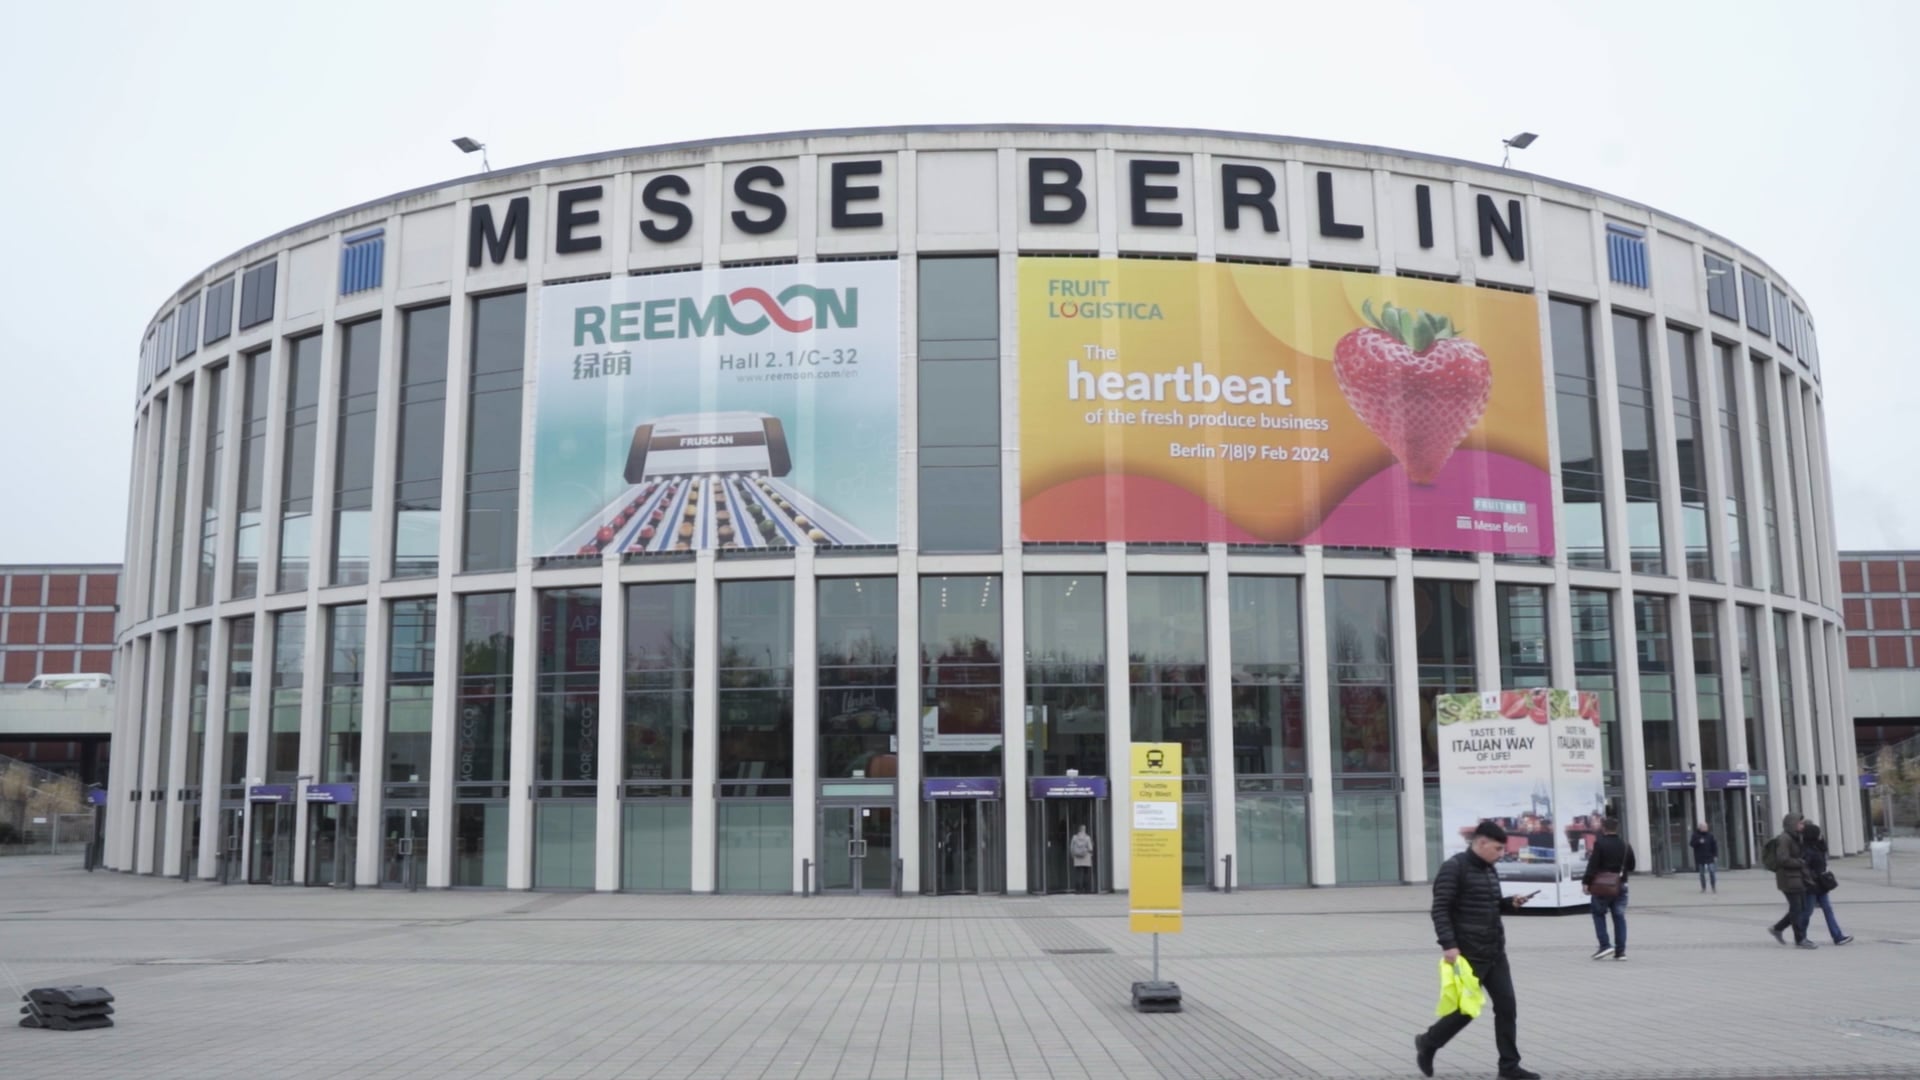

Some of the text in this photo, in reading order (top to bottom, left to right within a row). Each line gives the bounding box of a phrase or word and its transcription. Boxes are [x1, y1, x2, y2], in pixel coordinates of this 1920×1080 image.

[468, 156, 1525, 268] MESSE BERLIN
[1049, 279, 1110, 298] FRUIT
[720, 348, 859, 371] Hall 2.1/C-32
[1083, 344, 1118, 361] The
[573, 350, 632, 380] 绿萌
[736, 367, 859, 382] www.reemoon.com/en
[1067, 360, 1292, 406] heartbeat
[1085, 409, 1329, 432] of the fresh produce business
[680, 435, 734, 447] FRUSCAN
[1169, 442, 1216, 459] Berlin
[1261, 446, 1289, 461] Feb
[1292, 446, 1330, 463] 2024
[1474, 520, 1528, 533] Messe Berlin
[1470, 727, 1516, 737] TASTE THE
[1452, 737, 1535, 752] ITALIAN WAY
[1476, 753, 1488, 761] OF
